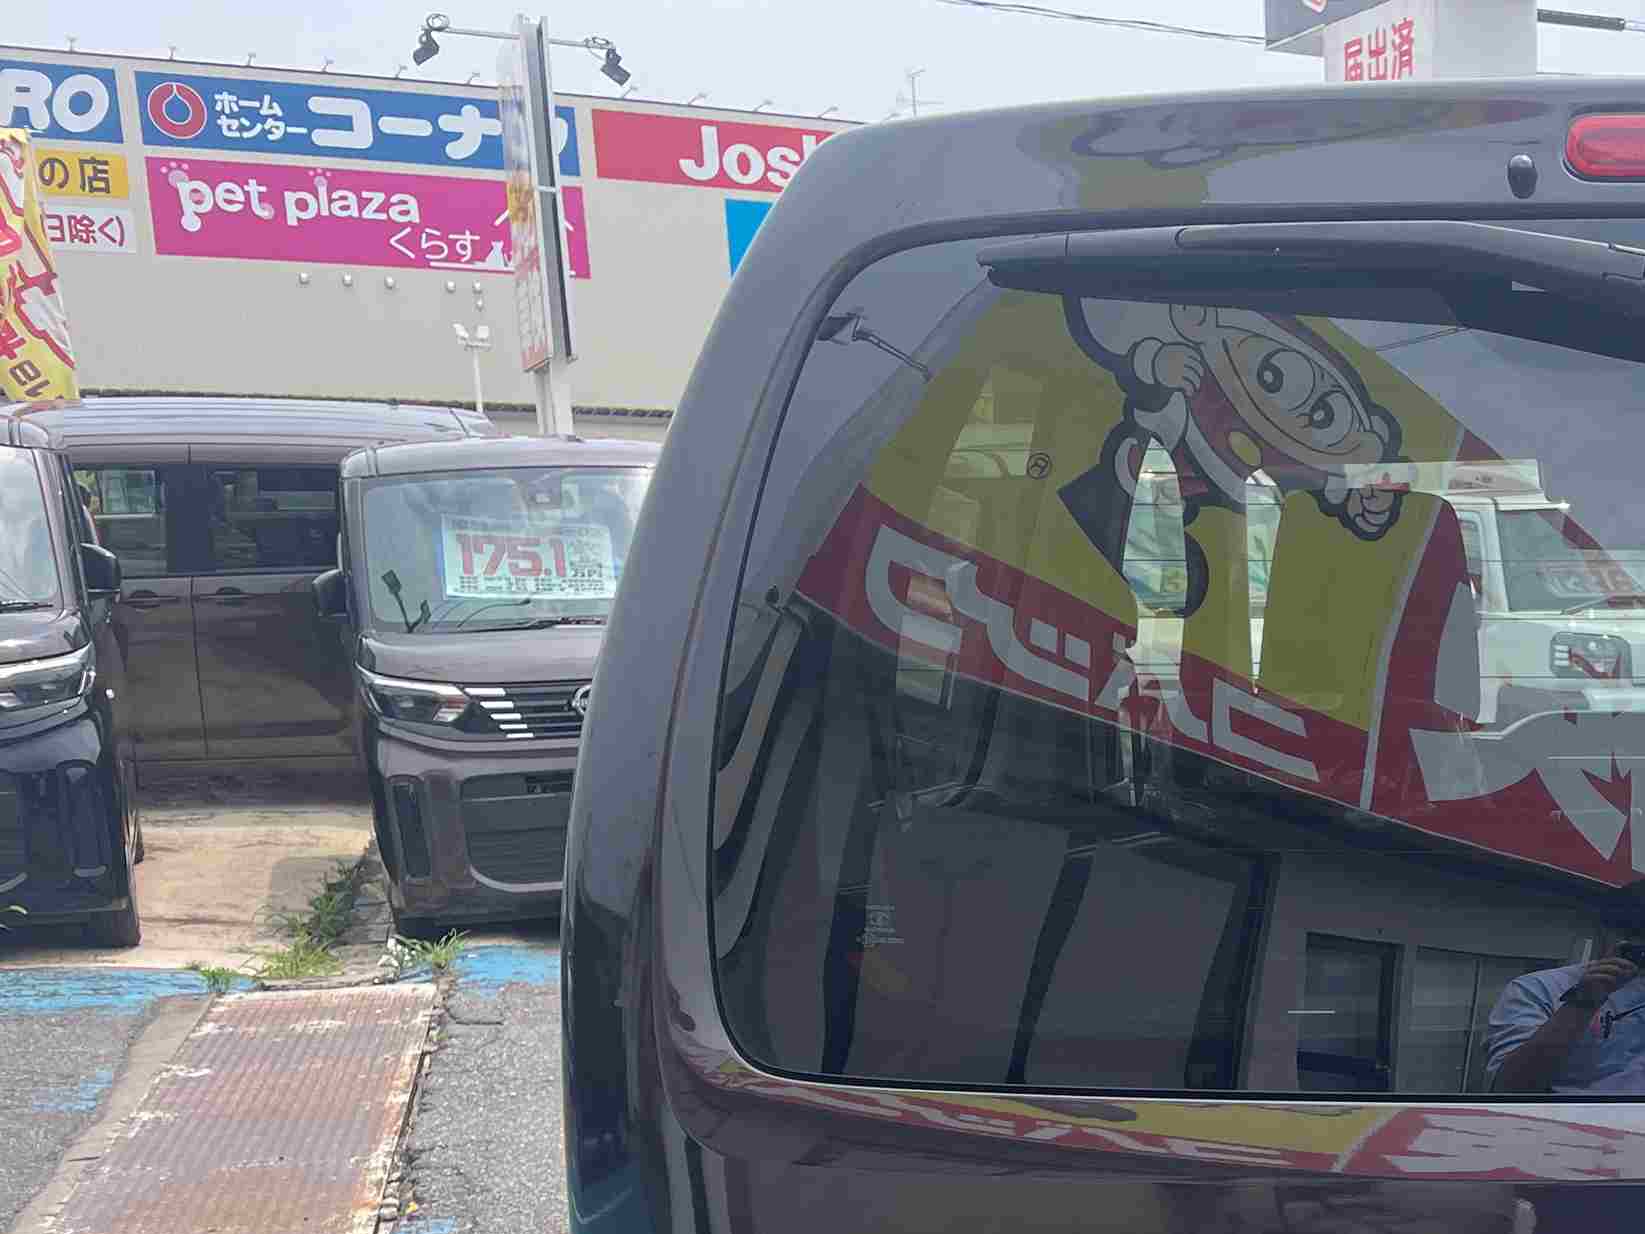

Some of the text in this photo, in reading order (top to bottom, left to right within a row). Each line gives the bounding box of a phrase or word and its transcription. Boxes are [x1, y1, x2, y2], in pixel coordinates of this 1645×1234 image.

[214, 91, 283, 117] ホーム
[216, 114, 308, 140] センター
[307, 96, 568, 161] コーナ
[38, 156, 111, 194] の店
[177, 176, 421, 232] pet plaza
